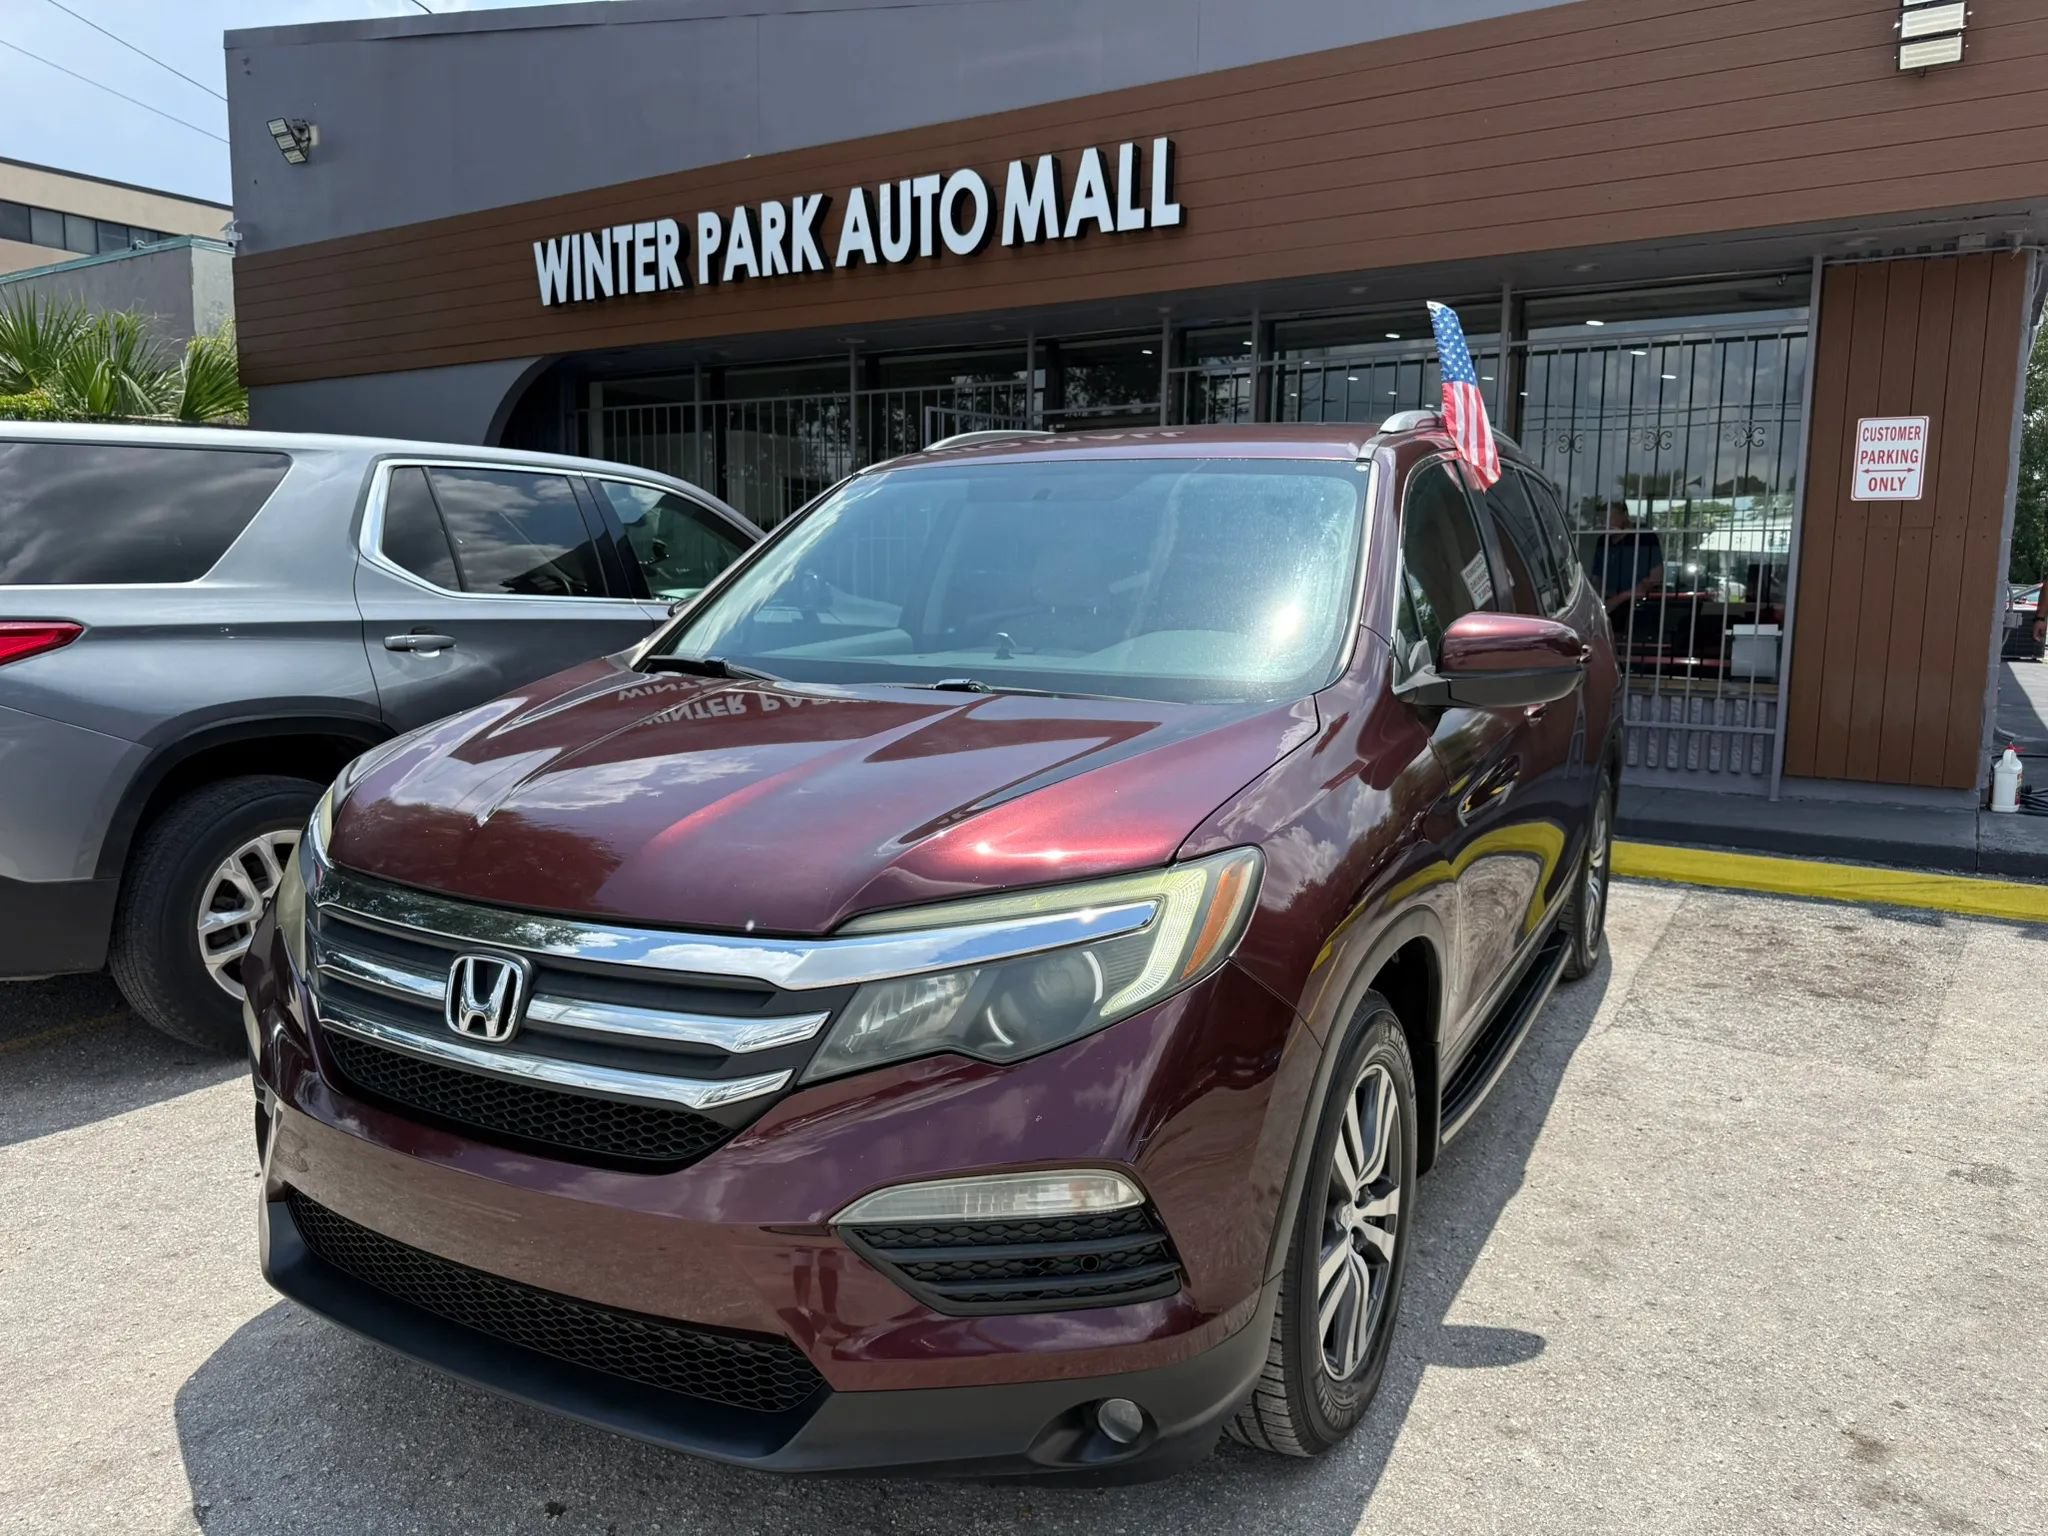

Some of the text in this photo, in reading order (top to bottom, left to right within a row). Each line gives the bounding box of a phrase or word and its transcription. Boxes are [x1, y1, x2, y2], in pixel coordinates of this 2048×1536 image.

[533, 136, 1181, 307] WINTER PARK AUTO MALL
[1862, 426, 1921, 441] CUSTOMER
[1860, 448, 1919, 464] PARKING
[1868, 476, 1906, 492] ONLY
